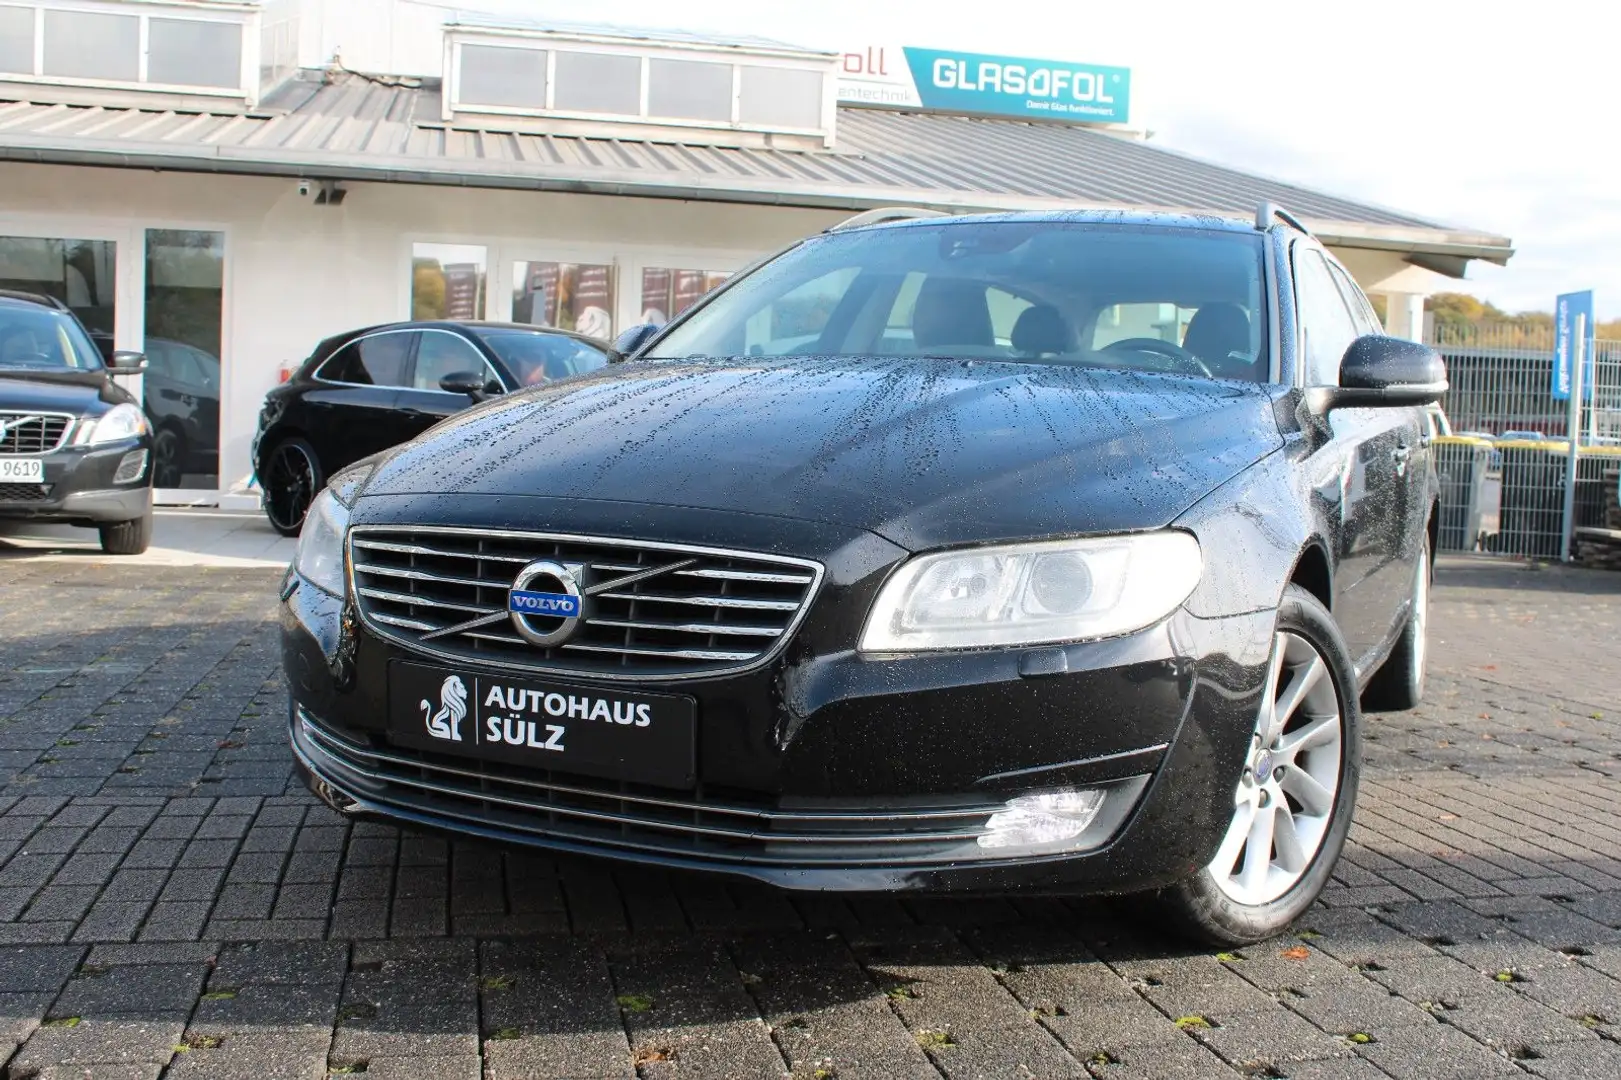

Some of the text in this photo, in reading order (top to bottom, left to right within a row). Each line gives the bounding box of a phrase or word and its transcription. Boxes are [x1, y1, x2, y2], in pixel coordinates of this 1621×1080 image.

[3, 461, 40, 476] 9619
[512, 594, 575, 612] VOLVO
[484, 685, 651, 727] AUTOHAUS
[486, 713, 566, 752] SÜLZ
